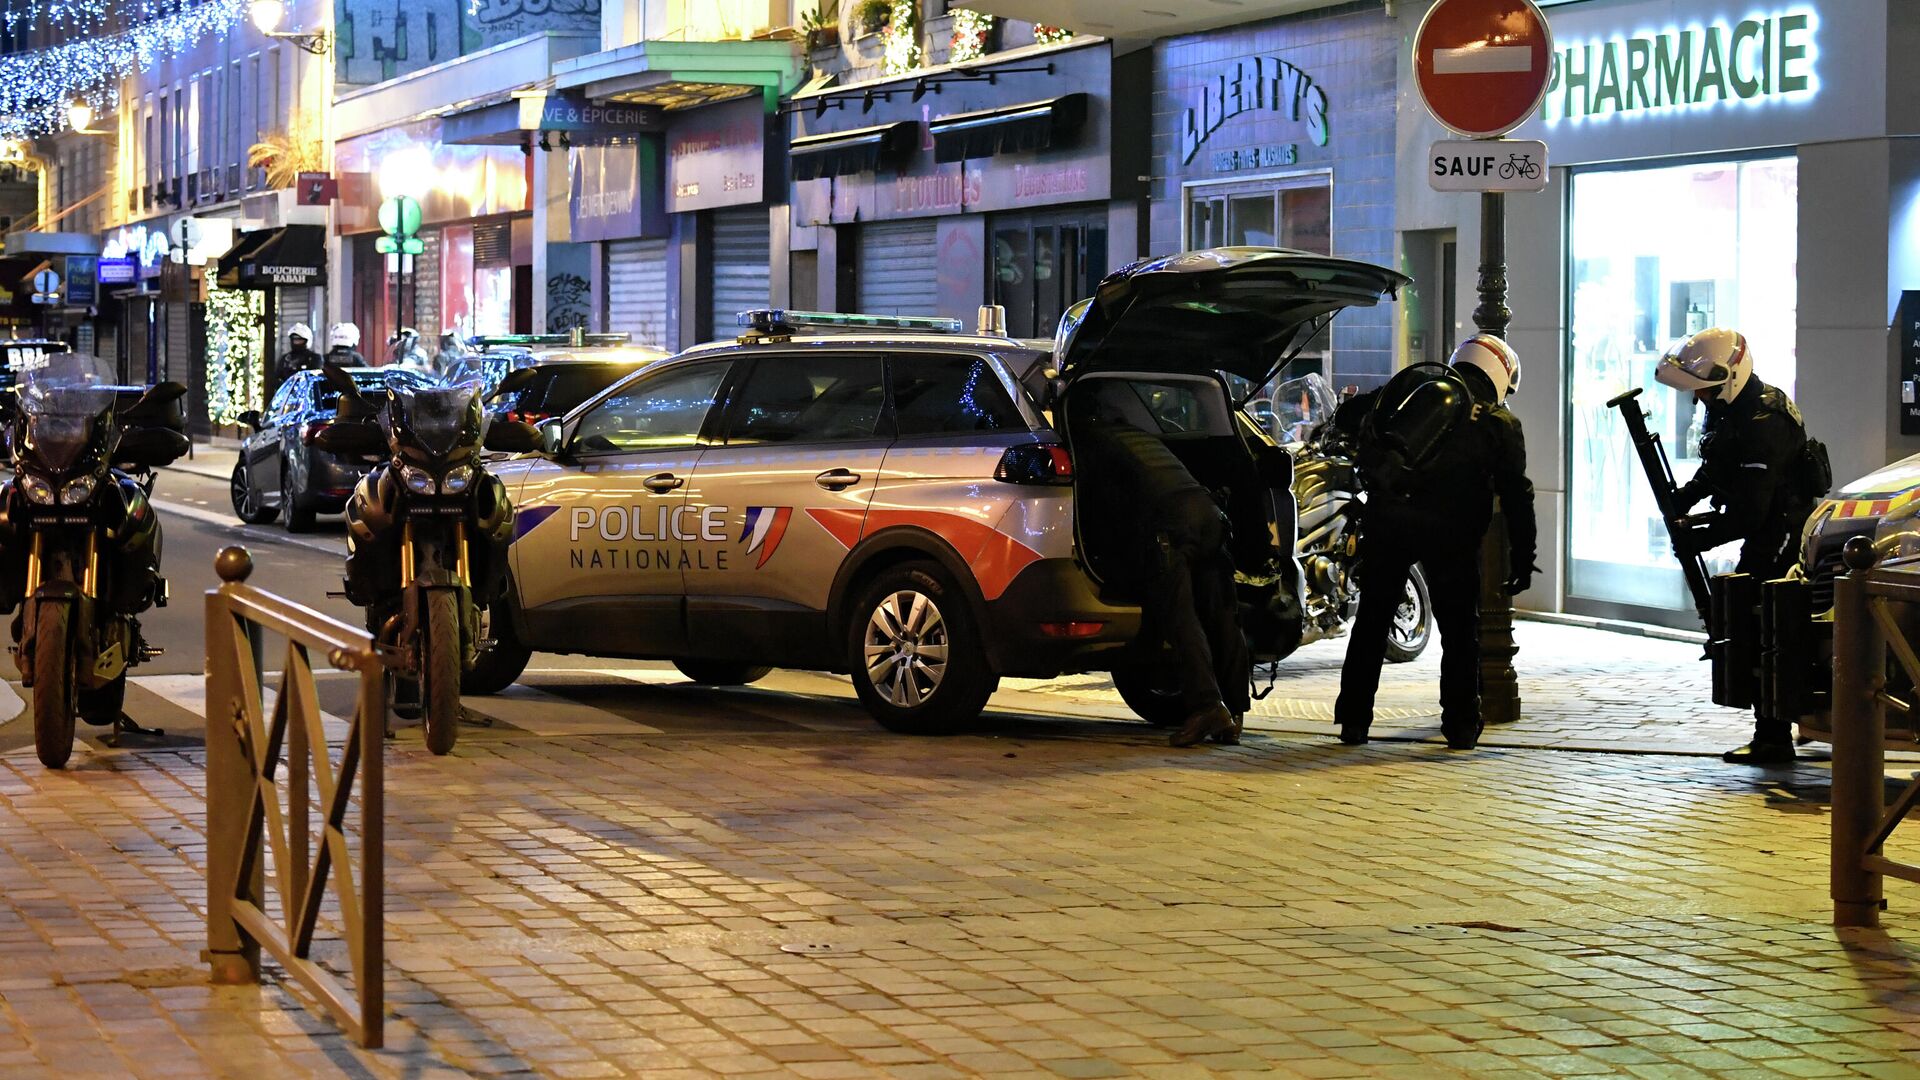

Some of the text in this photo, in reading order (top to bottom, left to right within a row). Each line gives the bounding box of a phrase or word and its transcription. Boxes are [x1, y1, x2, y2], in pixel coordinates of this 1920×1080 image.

[1539, 14, 1808, 121] PHARMACIE
[567, 108, 579, 122] &
[582, 106, 648, 125] ÉPICERIE
[1182, 56, 1328, 166] LIBERTY'S
[1434, 157, 1495, 176] SAUF
[262, 265, 318, 276] BOUCHERIE
[273, 275, 306, 283] RABAH
[570, 505, 729, 542] POLICE
[570, 548, 729, 570] NATIONALE
